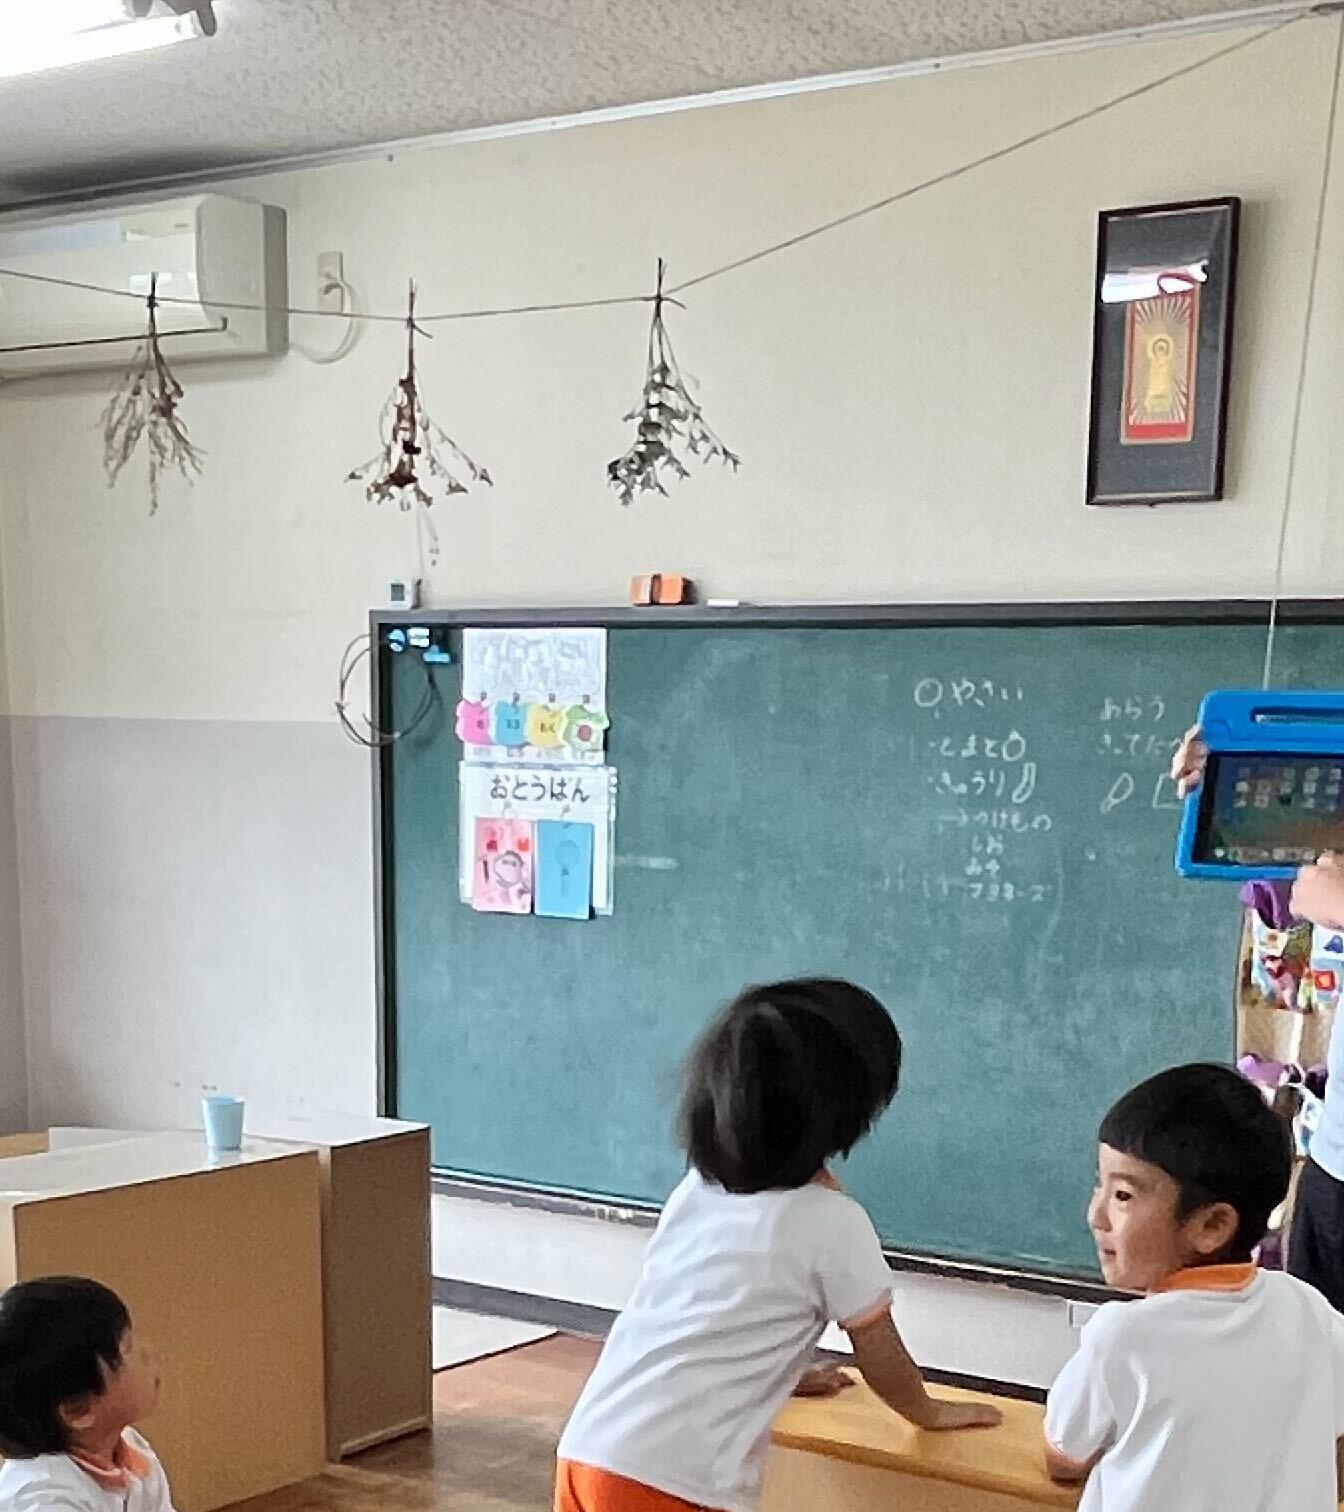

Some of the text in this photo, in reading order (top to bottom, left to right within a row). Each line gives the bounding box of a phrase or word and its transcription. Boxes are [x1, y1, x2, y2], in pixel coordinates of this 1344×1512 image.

[490, 774, 590, 803] おとうばん
